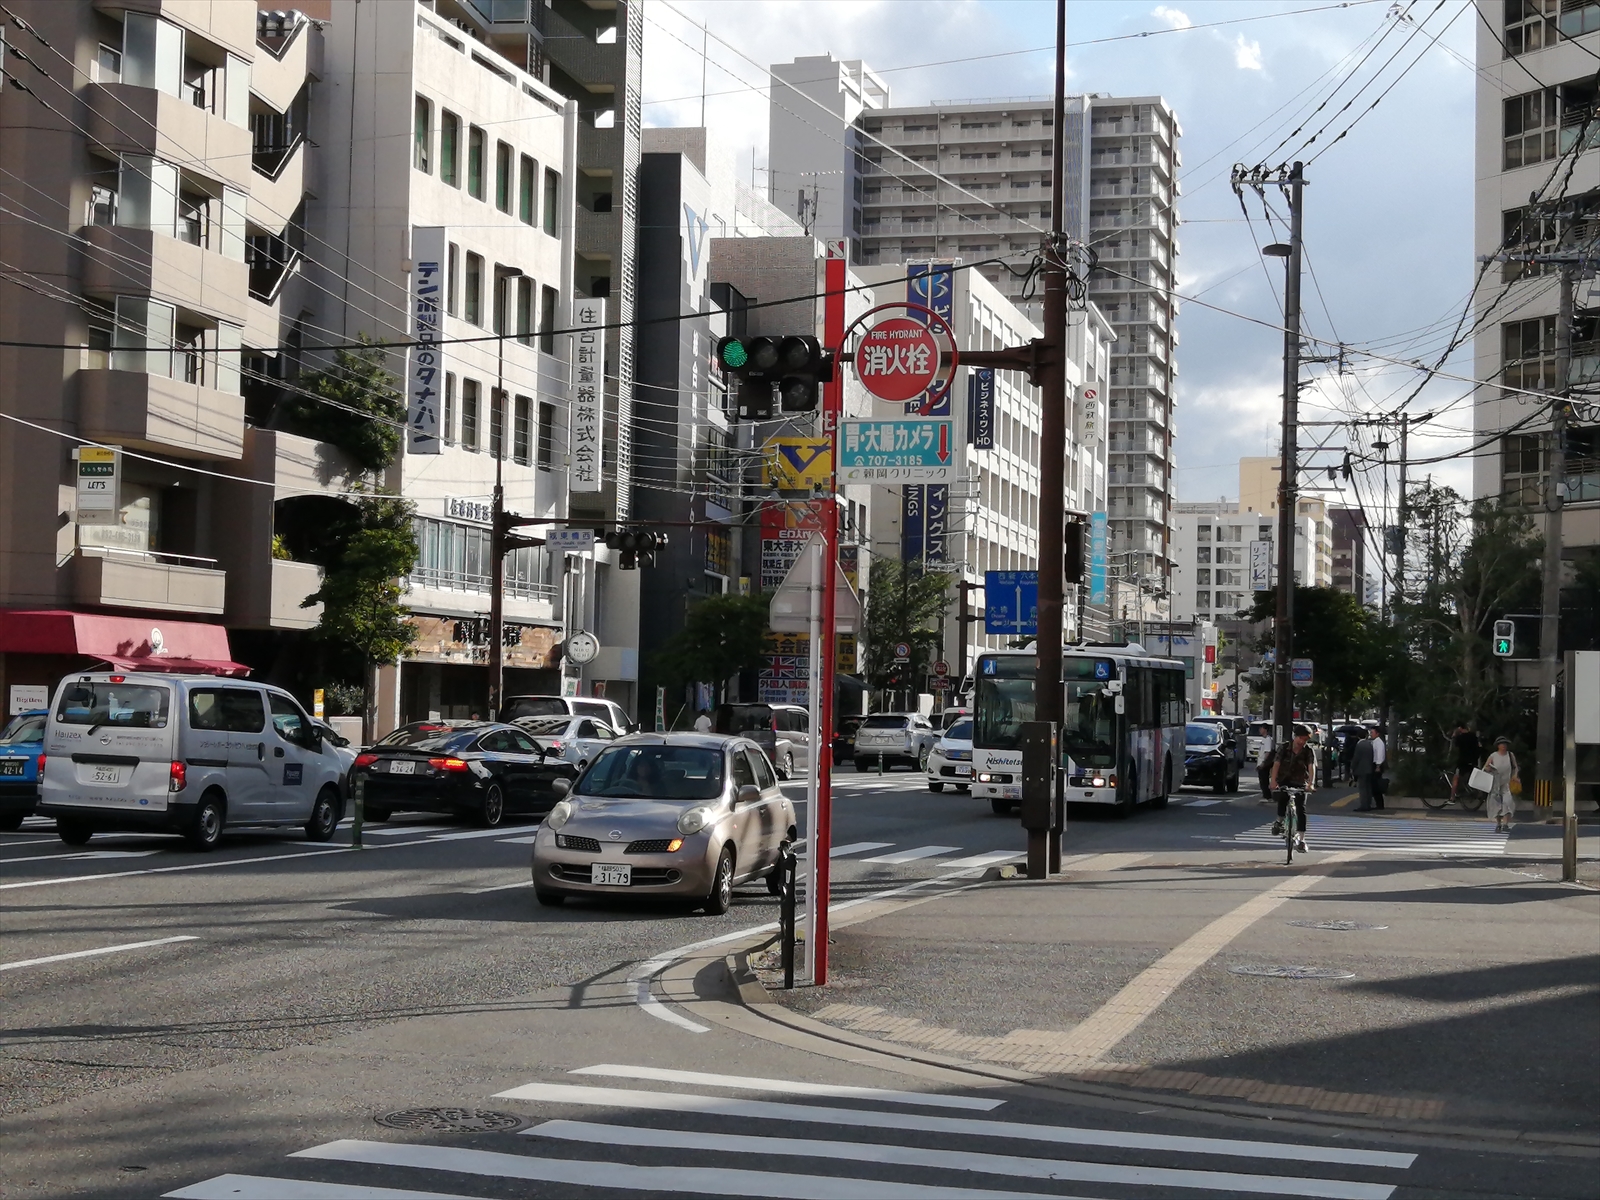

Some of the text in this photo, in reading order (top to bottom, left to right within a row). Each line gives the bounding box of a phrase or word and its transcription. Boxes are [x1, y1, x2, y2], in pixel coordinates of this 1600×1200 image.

[871, 329, 924, 340] FIRE HYDRANT
[863, 343, 931, 376] 消火栓
[868, 455, 923, 466] 707-3185
[87, 481, 106, 490] LET'S
[1021, 572, 1039, 580] 六本
[985, 756, 1022, 766] Nishitets
[3, 766, 23, 775] 42-14
[95, 771, 117, 781] 52-61
[600, 872, 629, 884] 31-79
